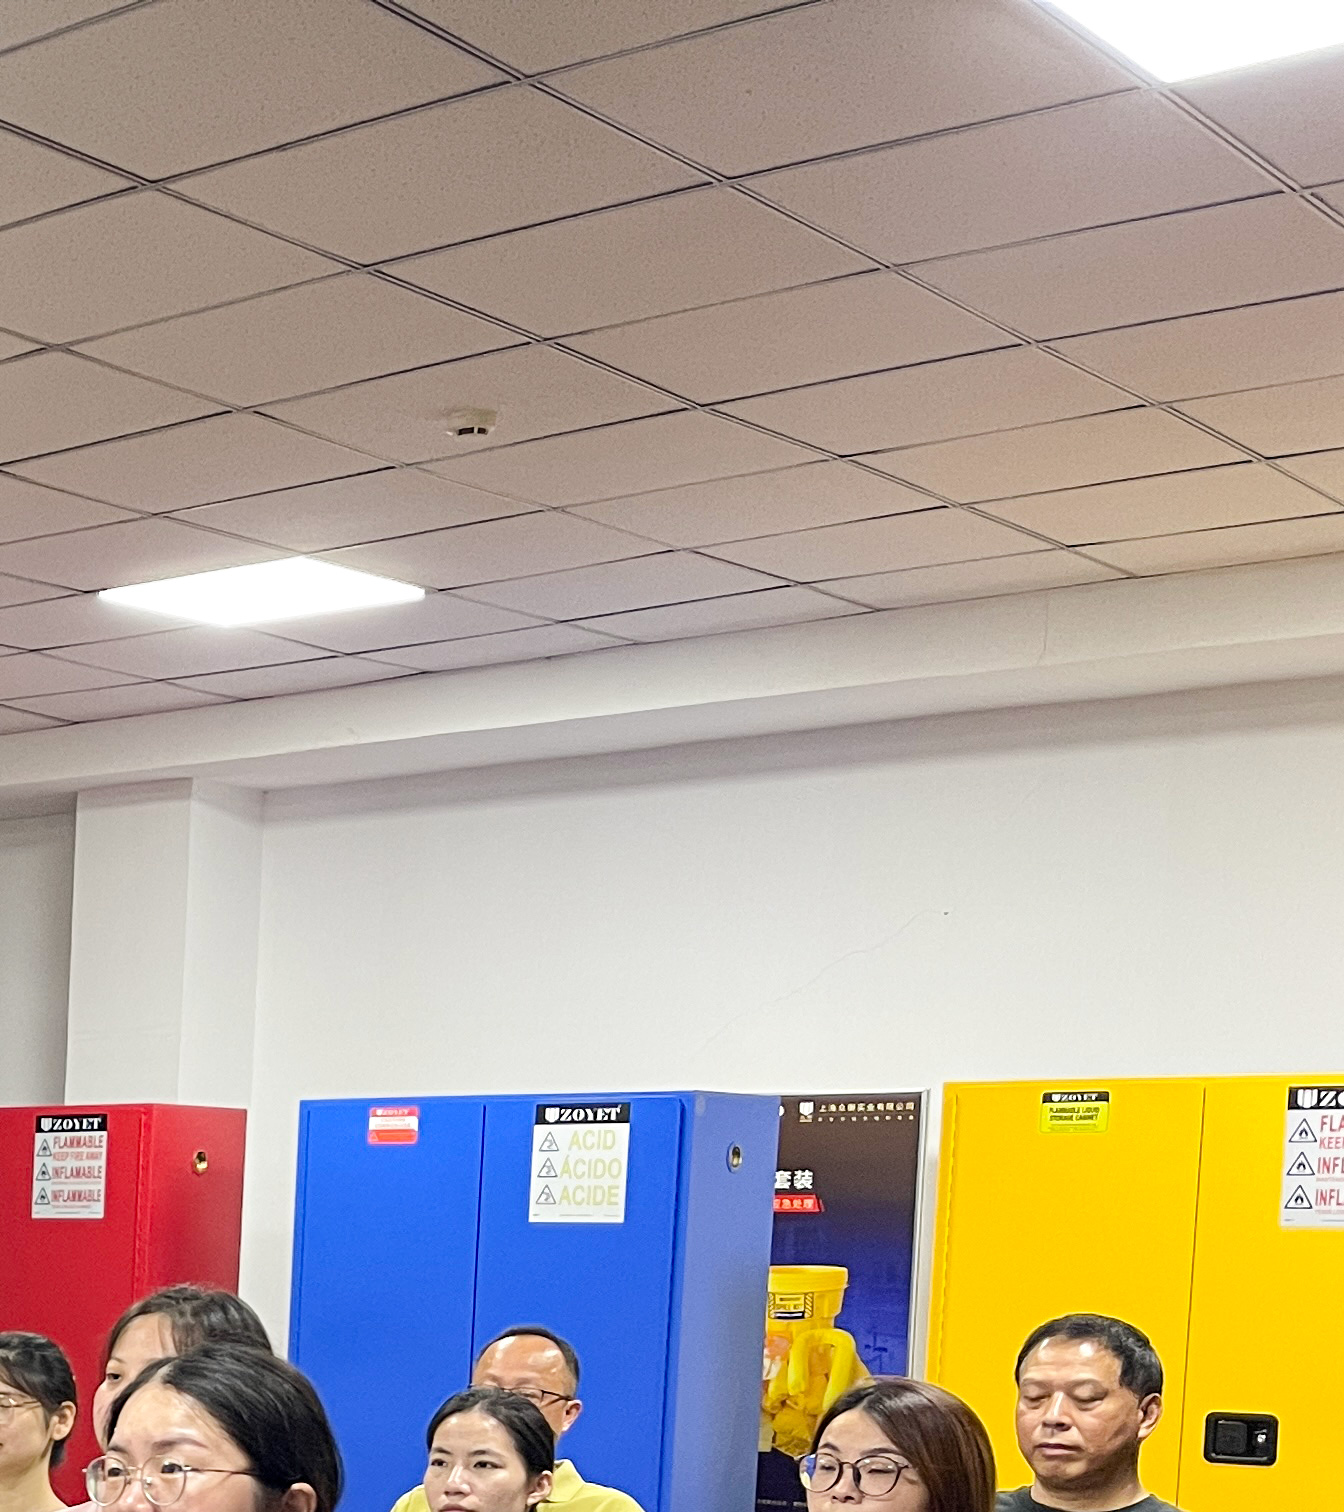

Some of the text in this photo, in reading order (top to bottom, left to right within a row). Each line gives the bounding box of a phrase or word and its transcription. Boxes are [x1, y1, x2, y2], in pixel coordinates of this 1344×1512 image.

[1060, 1093, 1099, 1102] ZOYET
[559, 1106, 621, 1121] ZOYET
[52, 1117, 102, 1130] ZOYET
[53, 1135, 104, 1149] FLAMMABLE
[568, 1129, 616, 1151] ACID
[559, 1154, 623, 1180] ÁCIDO
[558, 1185, 620, 1206] ACIDE
